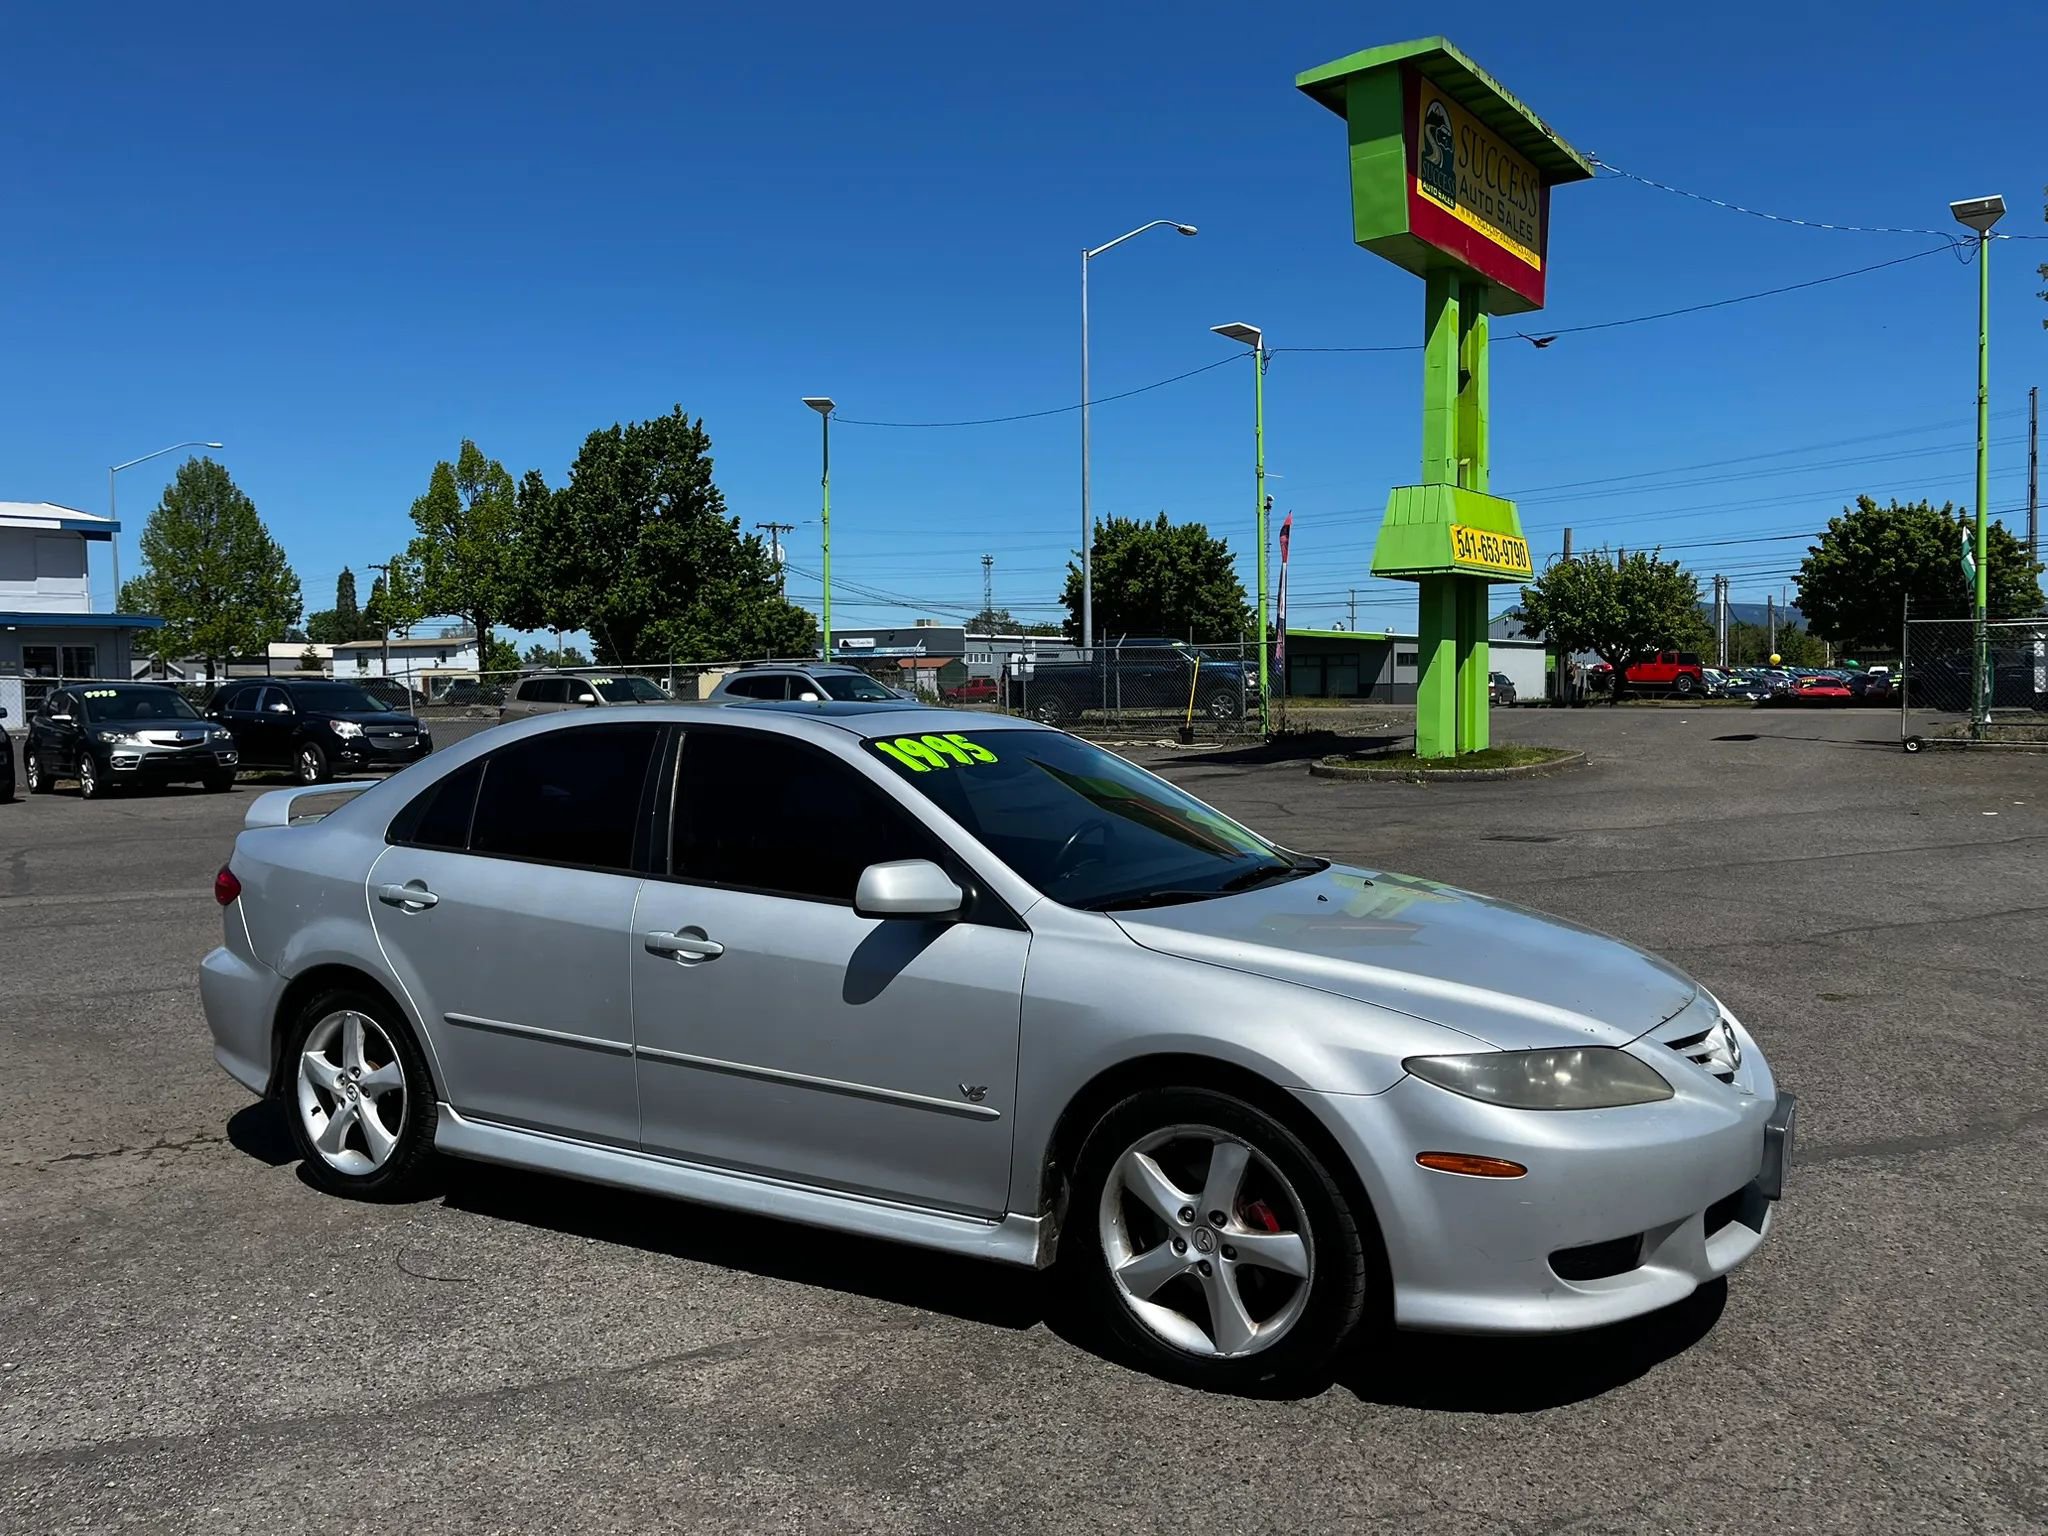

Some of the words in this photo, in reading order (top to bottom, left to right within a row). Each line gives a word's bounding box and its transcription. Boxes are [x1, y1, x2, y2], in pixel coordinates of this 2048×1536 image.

[1422, 160, 1456, 196] SUCCESS
[1459, 125, 1537, 217] SUCCESS
[1423, 181, 1438, 195] AUTO
[1438, 191, 1454, 207] SALES
[1459, 178, 1493, 215] AUTO
[1498, 202, 1533, 242] SALES
[1457, 529, 1527, 567] 541-653-9790
[875, 734, 998, 772] 1995
[958, 1083, 988, 1102] V6
